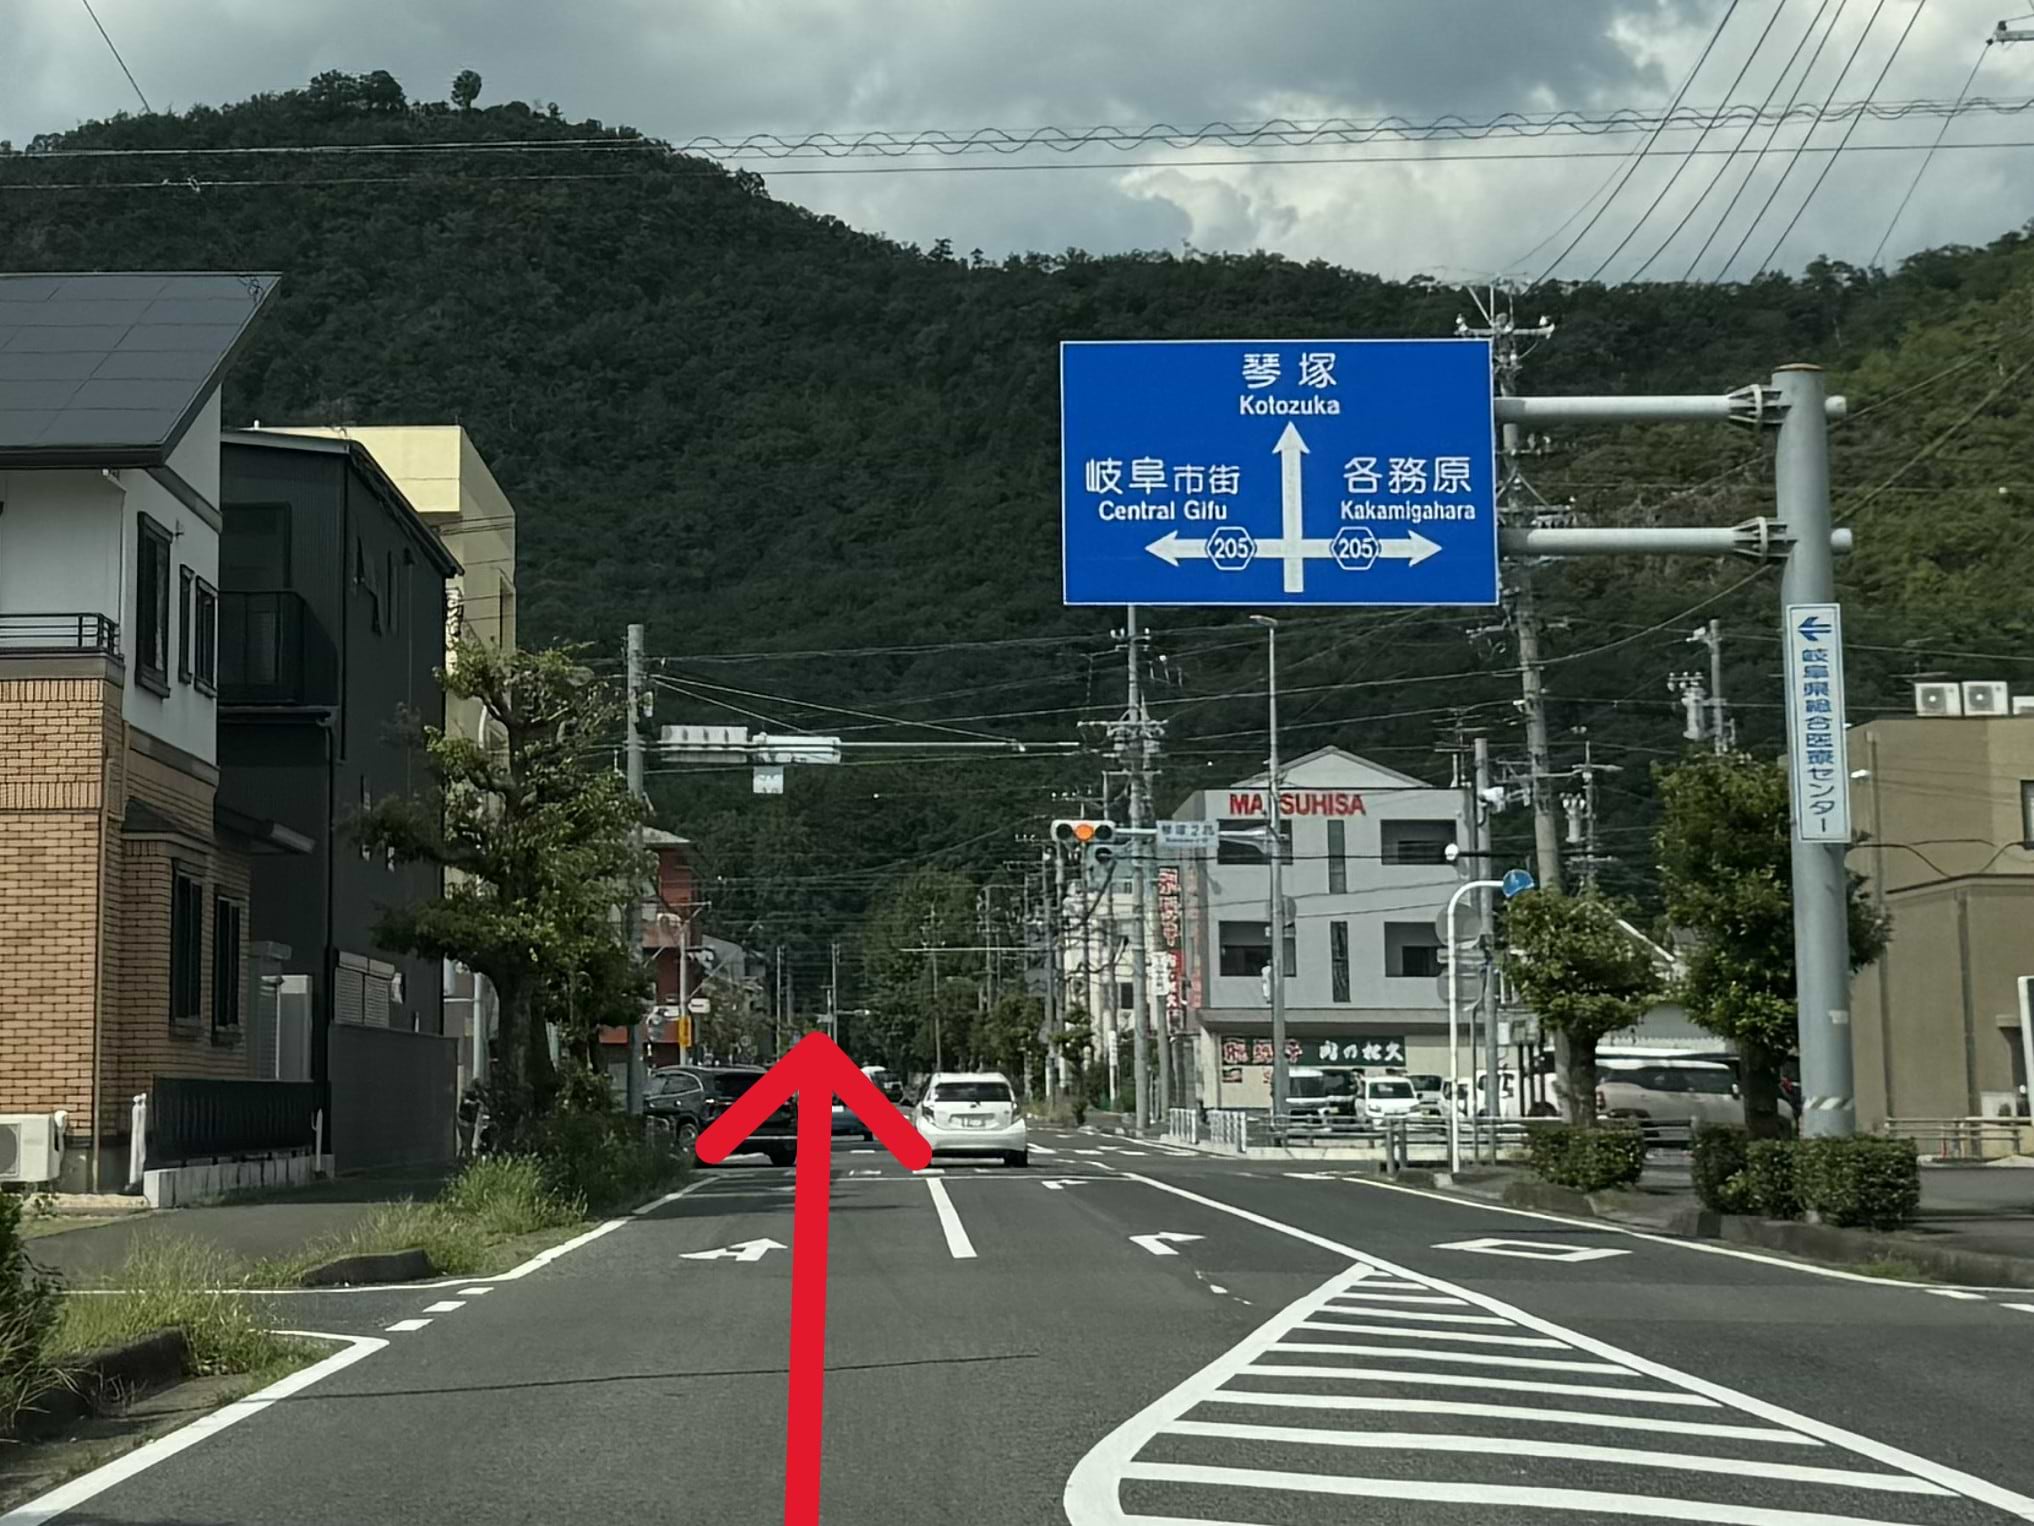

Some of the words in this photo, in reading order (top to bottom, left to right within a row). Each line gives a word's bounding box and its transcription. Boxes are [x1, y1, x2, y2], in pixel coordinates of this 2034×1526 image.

[1243, 353, 1336, 388] 琴塚
[1240, 395, 1340, 414] Kotozuka
[1086, 457, 1240, 494] 岐阜市街
[1344, 457, 1471, 493] 各務原
[1099, 501, 1175, 520] Central
[1184, 500, 1227, 520] Gifu
[1341, 501, 1475, 523] Kakamigahara
[1214, 538, 1249, 560] 205
[1338, 538, 1374, 560] 205
[1230, 793, 1366, 816] MASUHISA
